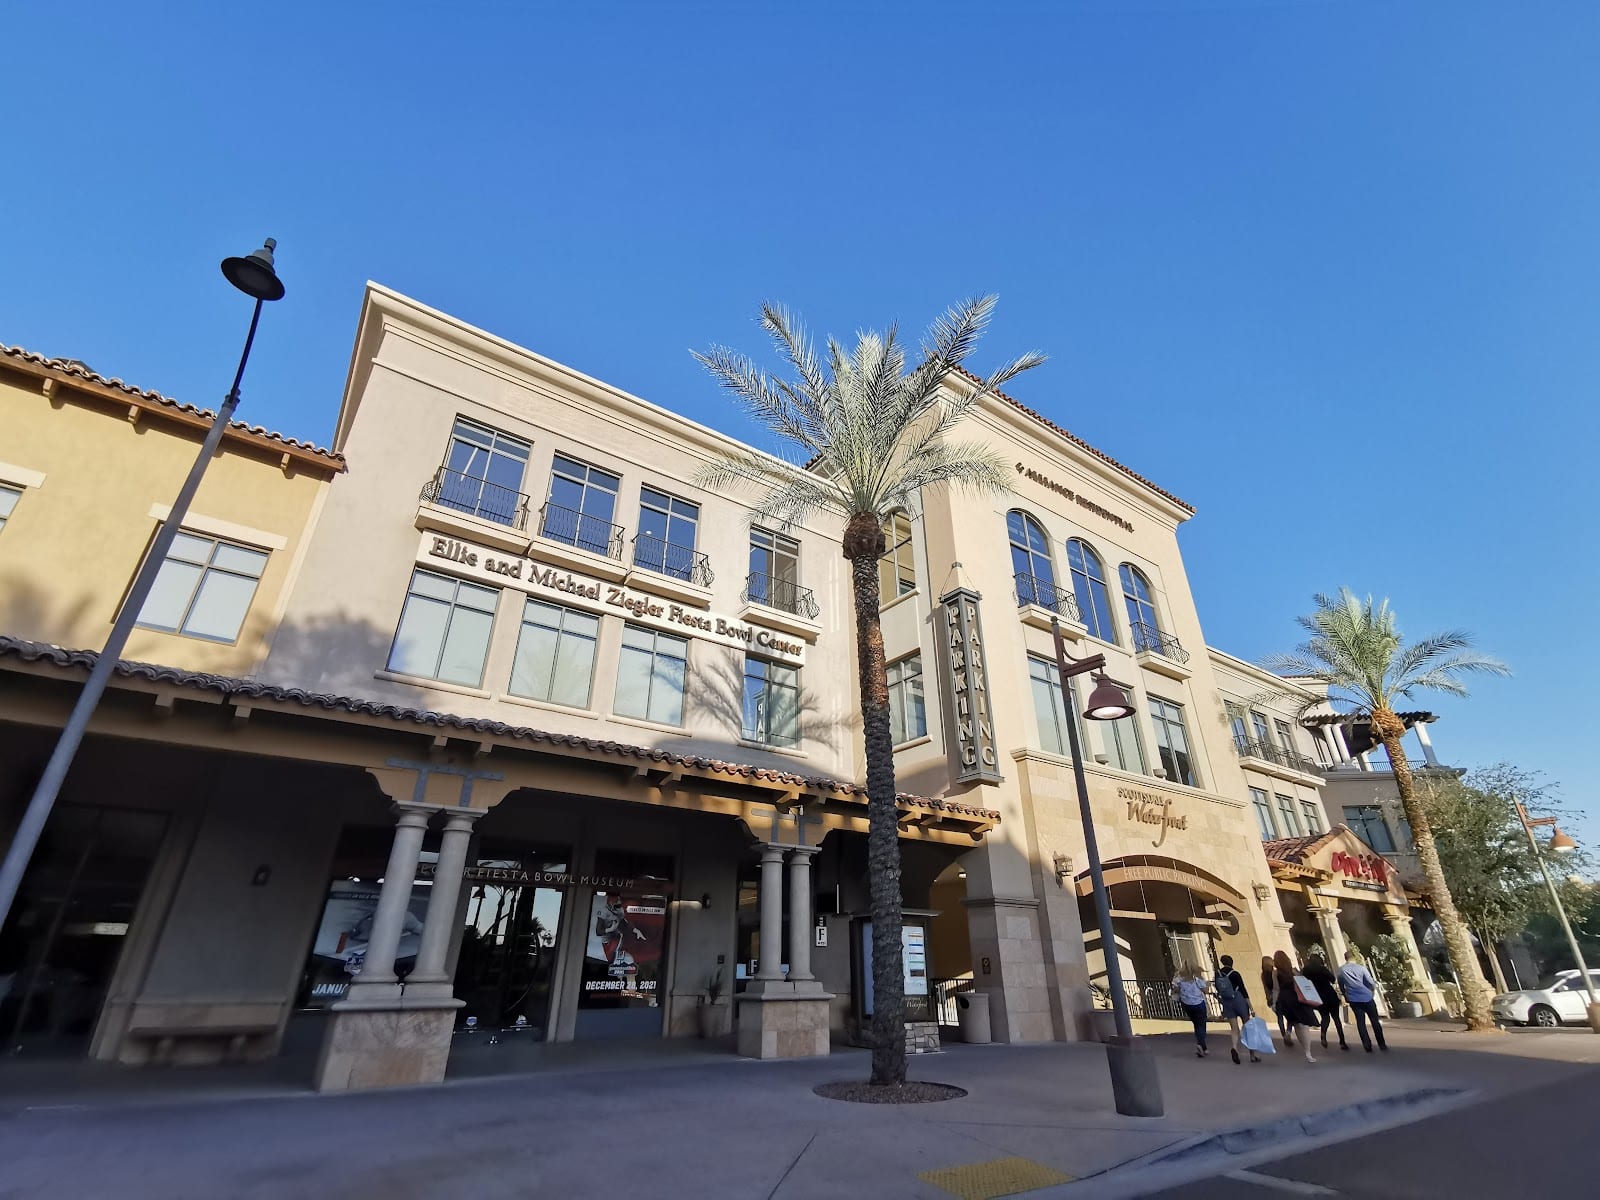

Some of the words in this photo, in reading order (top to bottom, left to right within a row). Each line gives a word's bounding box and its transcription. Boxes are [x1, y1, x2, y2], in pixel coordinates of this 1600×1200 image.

[429, 537, 478, 567] Ellie
[485, 557, 523, 579] and
[528, 564, 601, 601] Michael
[605, 587, 664, 617] Ziegler
[668, 604, 712, 631] Fiesta
[715, 618, 753, 642] Bowl
[757, 631, 803, 656] Center
[949, 606, 976, 768] PARKING
[966, 605, 996, 766] PARKING
[1127, 799, 1188, 847] Waterfront
[477, 869, 528, 880] FIESTA
[534, 871, 575, 884] BOWL
[581, 876, 634, 888] MUSEUM
[1124, 867, 1143, 880] FREE
[1144, 867, 1171, 880] PUBLIC
[1173, 870, 1207, 889] PARKING
[312, 983, 348, 995] JANU
[585, 981, 625, 990] DECEMBER
[639, 980, 657, 990] 2021
